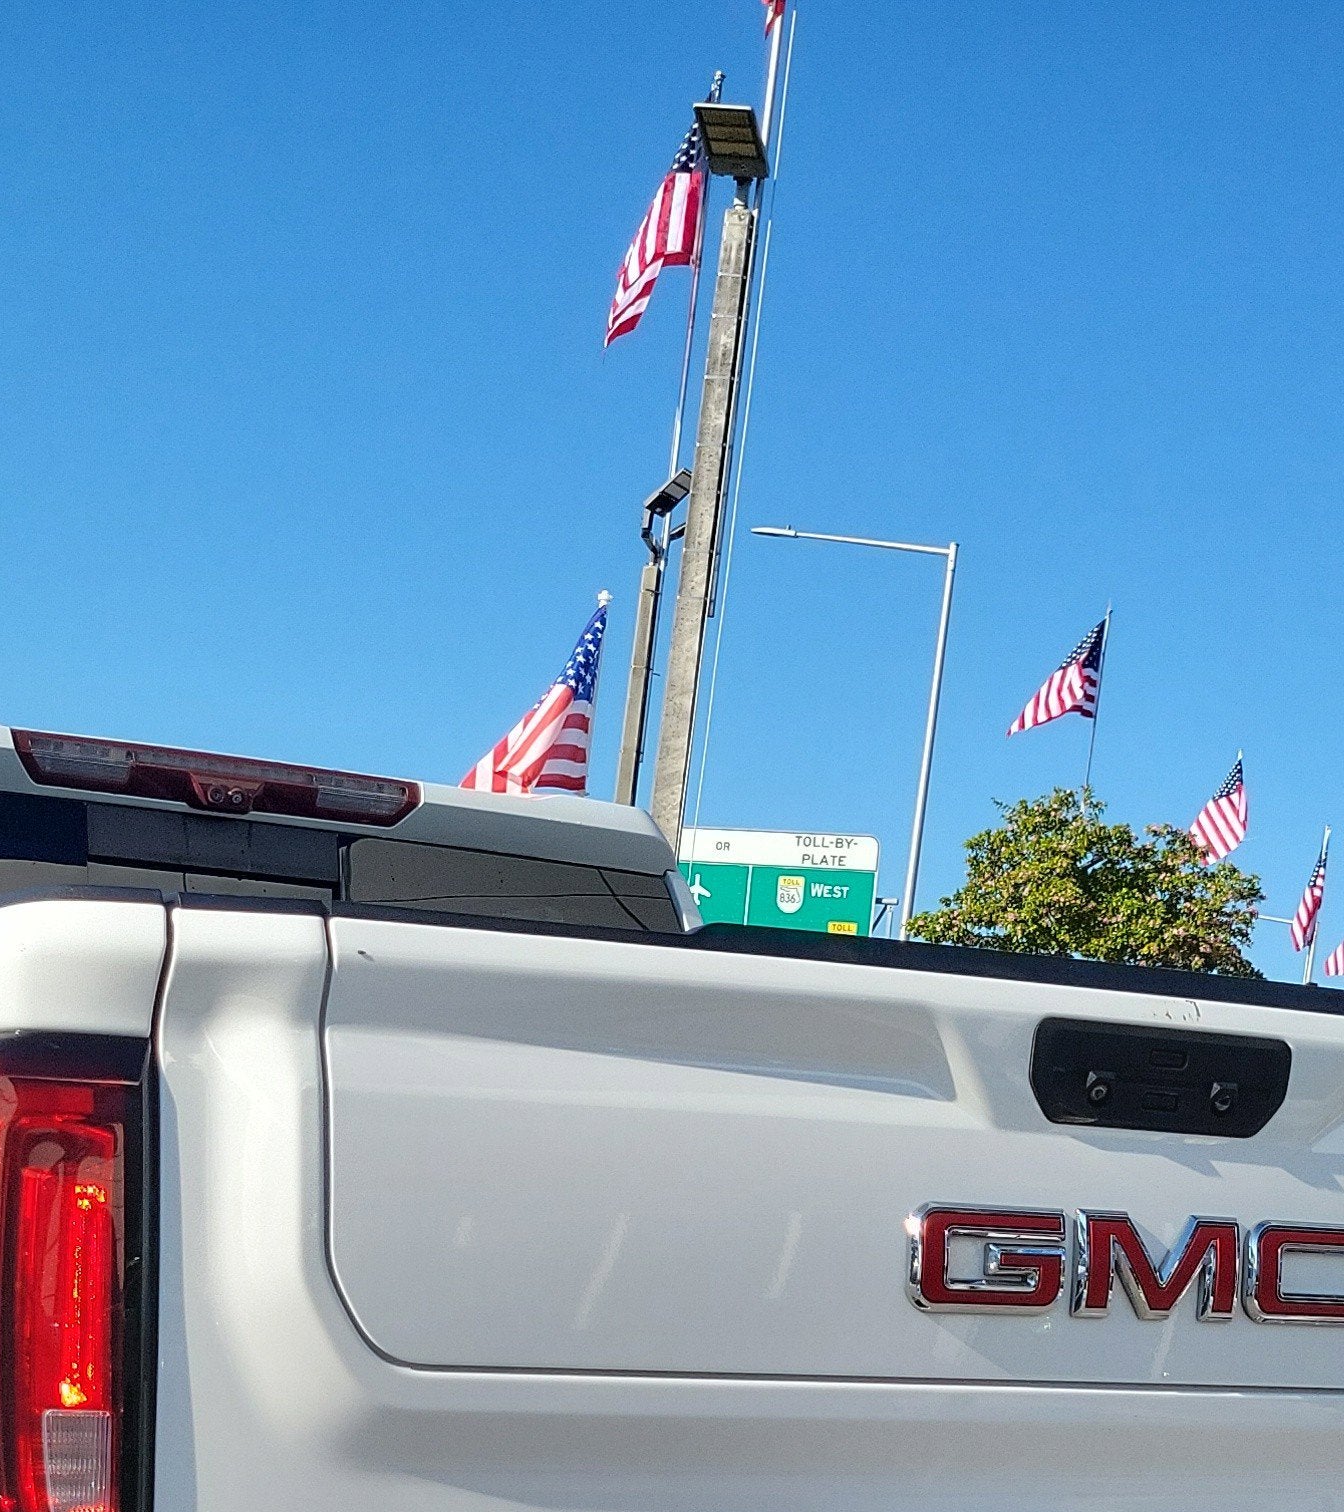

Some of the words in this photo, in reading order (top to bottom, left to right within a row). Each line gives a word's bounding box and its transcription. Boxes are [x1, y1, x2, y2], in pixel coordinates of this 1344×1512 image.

[715, 841, 731, 851] OR
[795, 836, 858, 849] TOLL-BY-
[801, 854, 847, 867] PLATE
[783, 878, 800, 886] TOLL
[810, 882, 849, 898] WEST
[779, 893, 796, 904] 836
[831, 923, 853, 932] TOLL
